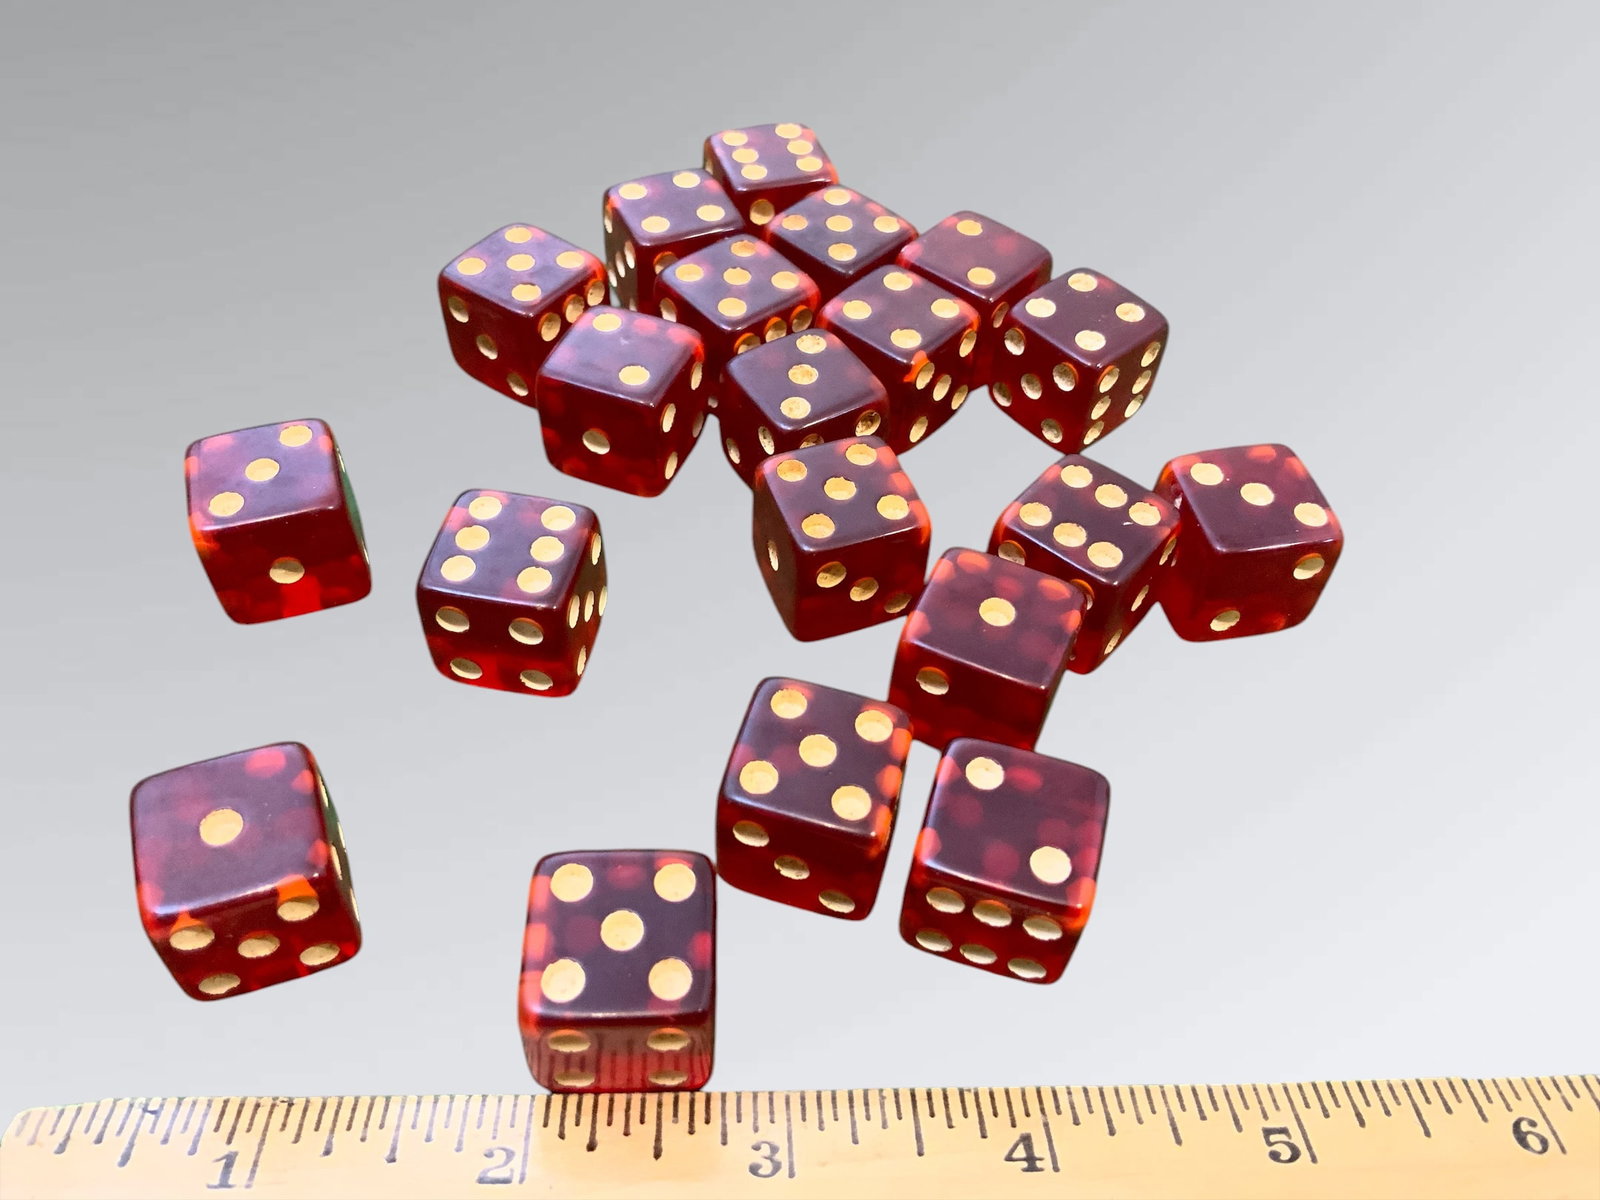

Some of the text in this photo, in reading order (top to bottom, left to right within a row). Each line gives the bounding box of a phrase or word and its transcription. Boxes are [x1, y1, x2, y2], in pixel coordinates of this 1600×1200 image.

[206, 1117, 1550, 1189] 1 2 3 4 5 6
